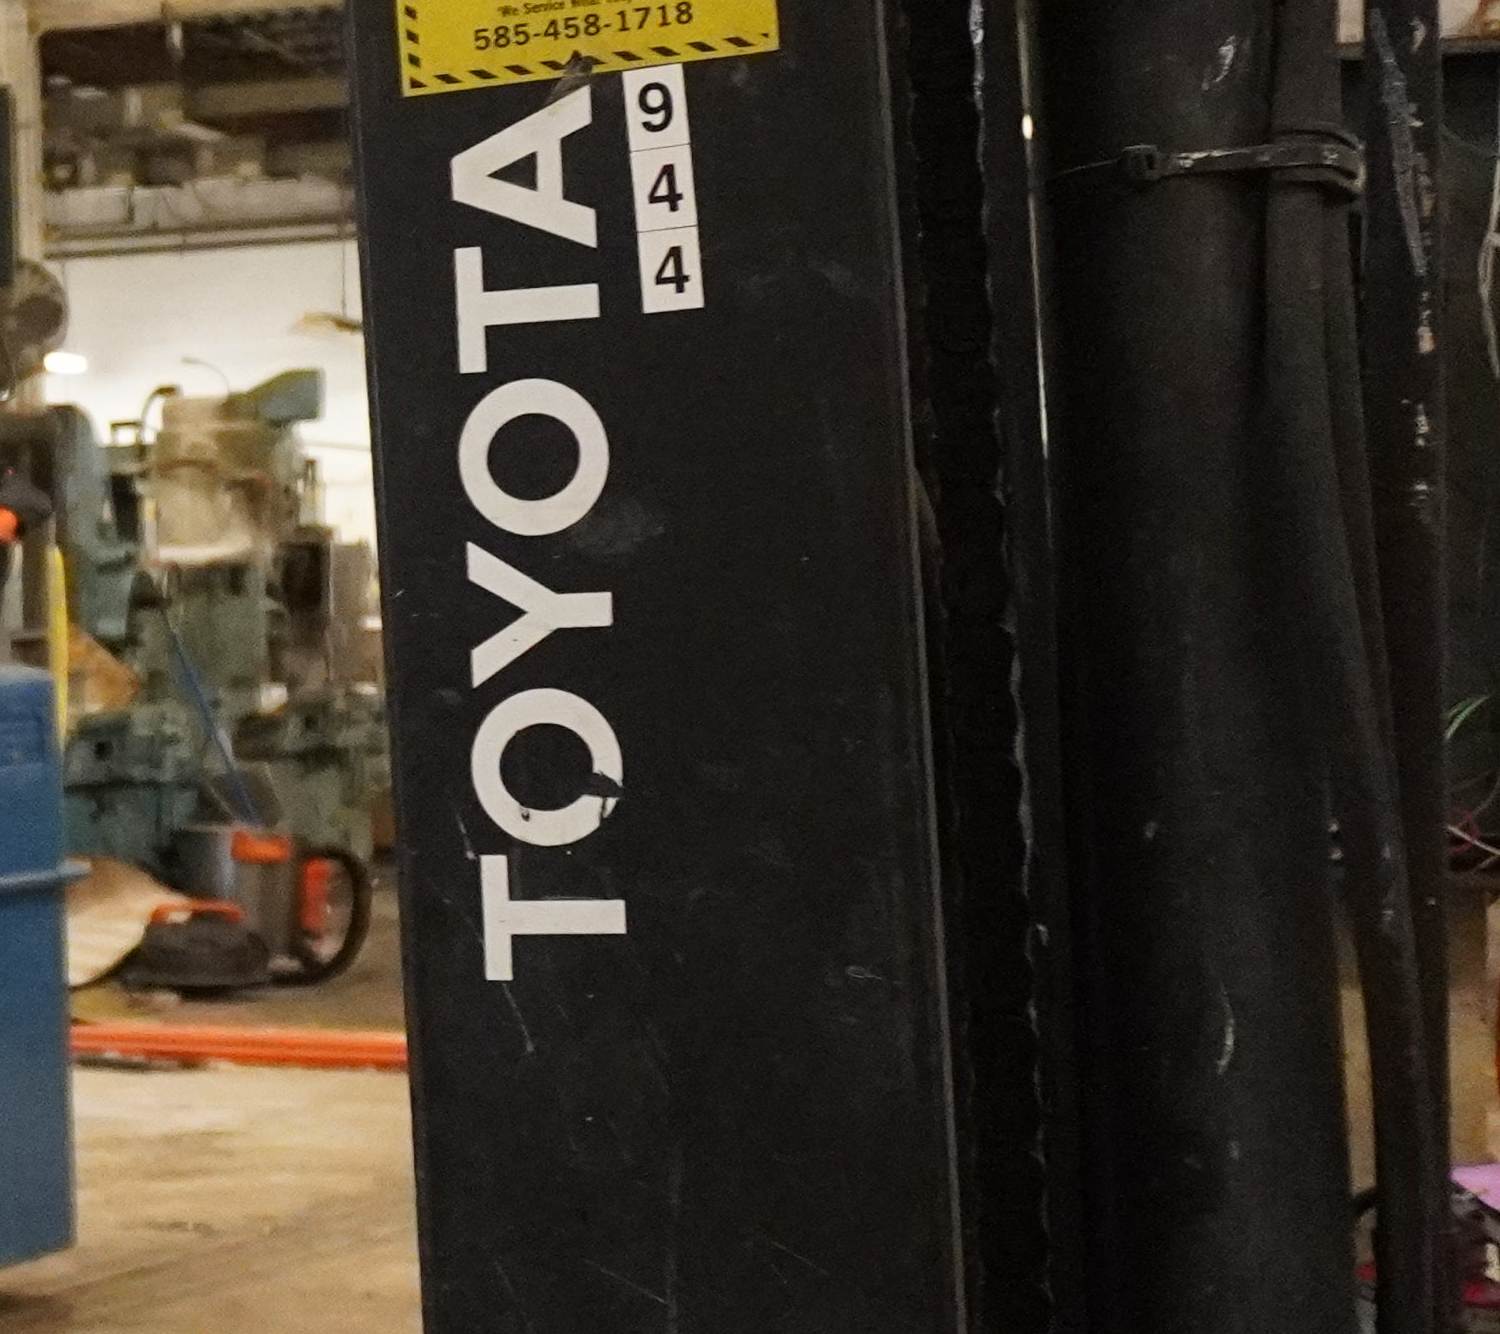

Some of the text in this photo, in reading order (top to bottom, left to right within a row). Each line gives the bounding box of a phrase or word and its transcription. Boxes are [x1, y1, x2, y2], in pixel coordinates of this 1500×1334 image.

[473, 1, 694, 51] 585-458-1718
[637, 81, 691, 295] 944
[450, 85, 628, 982] TOYOTA
